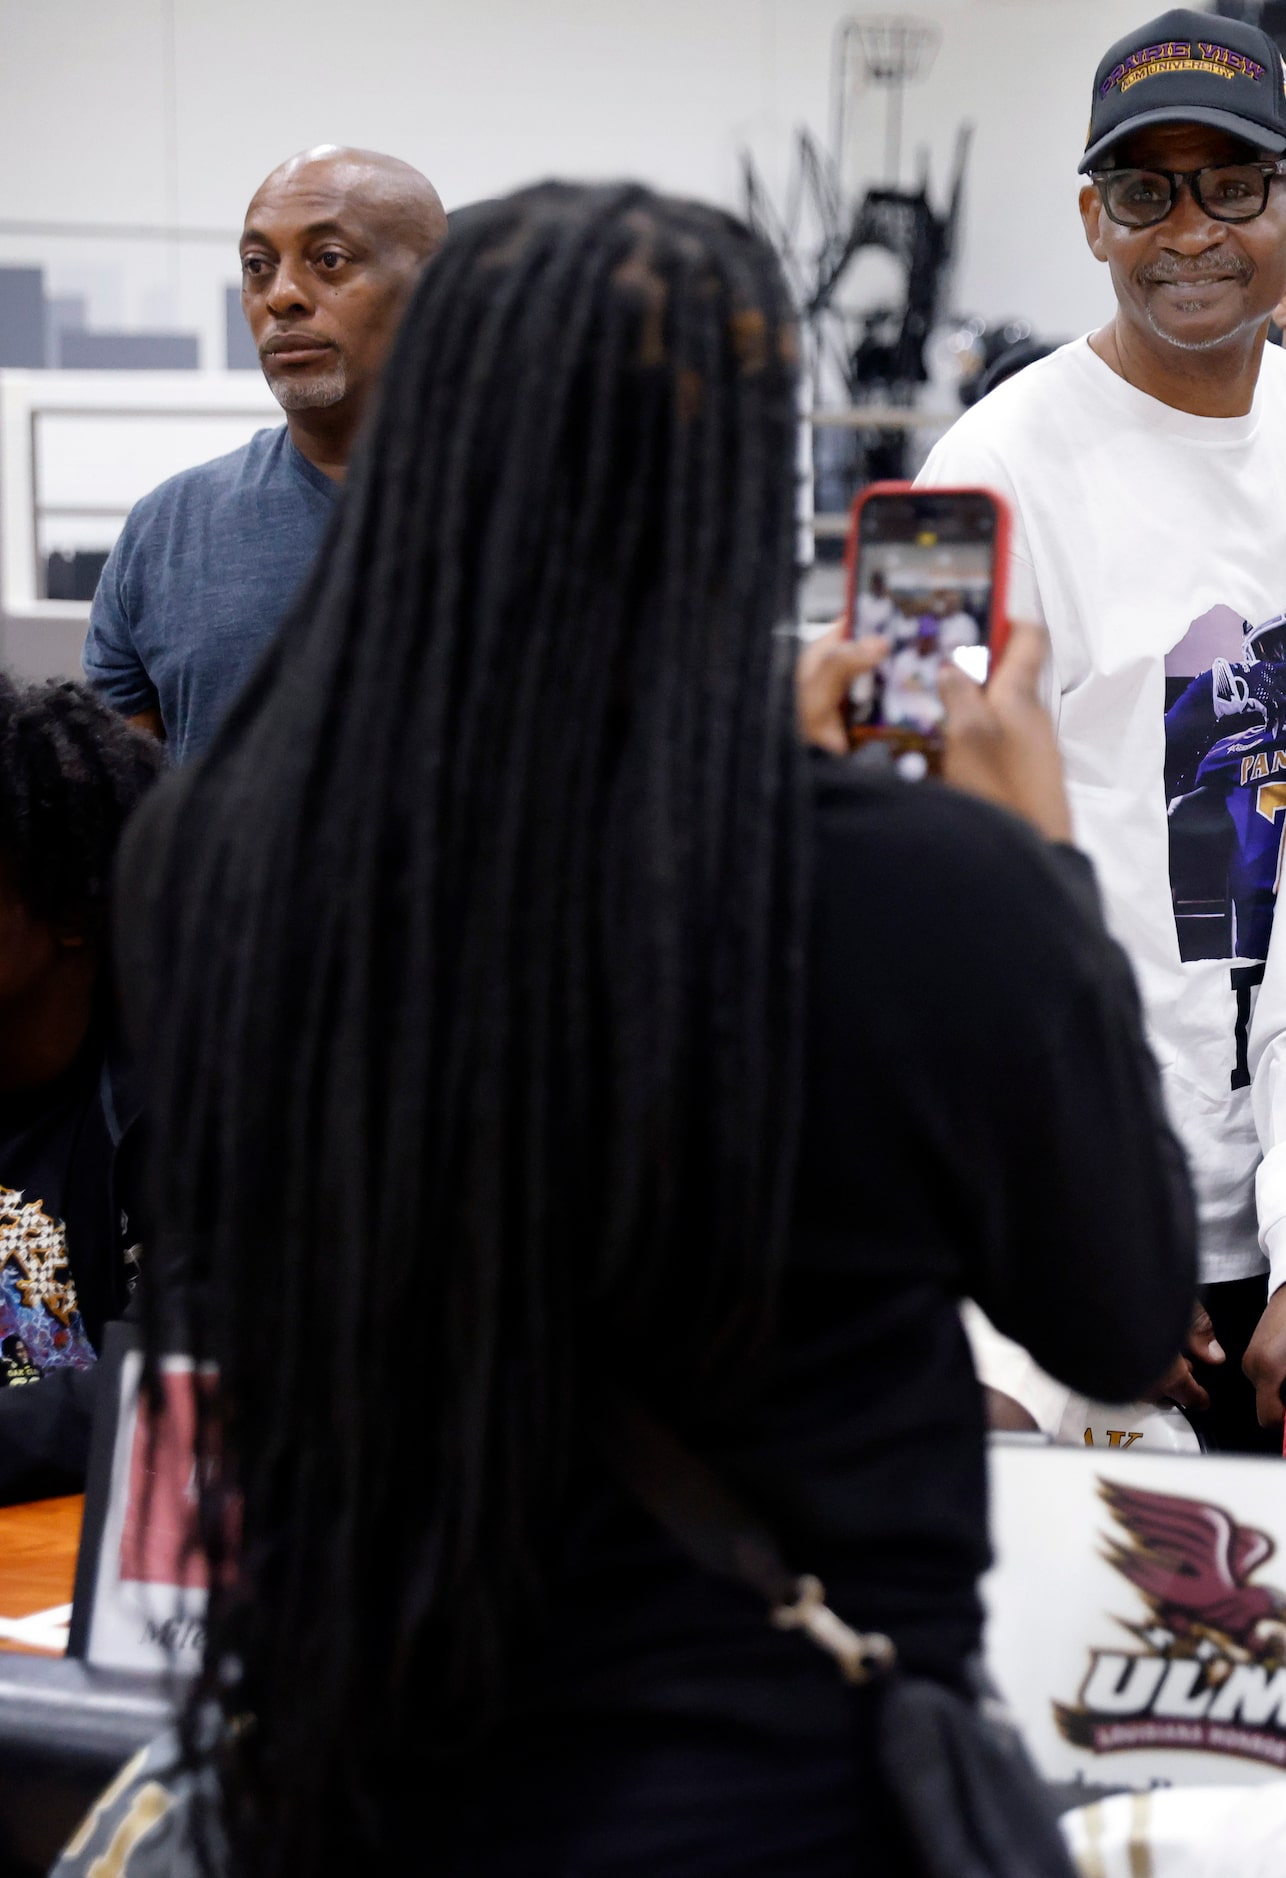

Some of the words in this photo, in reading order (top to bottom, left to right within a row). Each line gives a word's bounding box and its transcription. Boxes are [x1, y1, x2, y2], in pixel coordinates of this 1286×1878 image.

[1101, 41, 1191, 99] PRAIRIE
[1198, 42, 1265, 82] VIEW
[1150, 59, 1235, 80] UNIVERSITY
